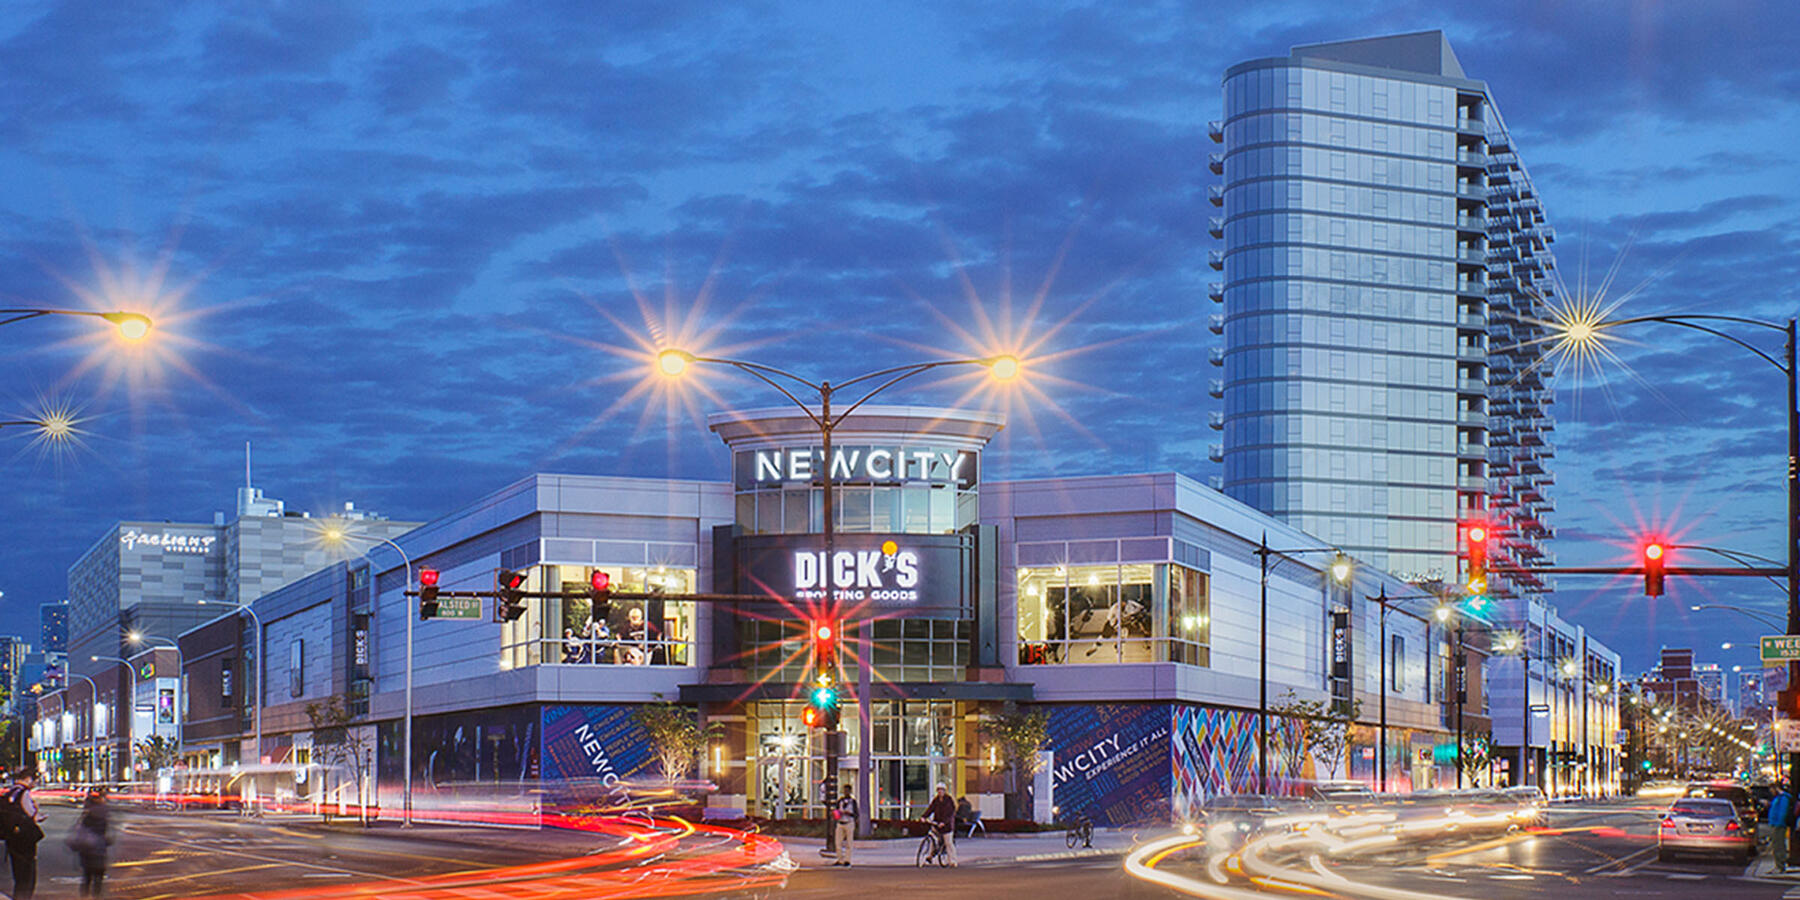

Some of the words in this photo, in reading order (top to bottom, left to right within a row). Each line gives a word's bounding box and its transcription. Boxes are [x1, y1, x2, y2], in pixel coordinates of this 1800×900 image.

[756, 449, 966, 481] NEWCITY
[795, 548, 918, 588] DICK'S
[438, 600, 471, 609] ALSTED
[871, 591, 917, 600] GOODS
[1085, 742, 1138, 780] EXPERIENCE
[1140, 736, 1149, 748] IT
[1151, 727, 1168, 742] ALL
